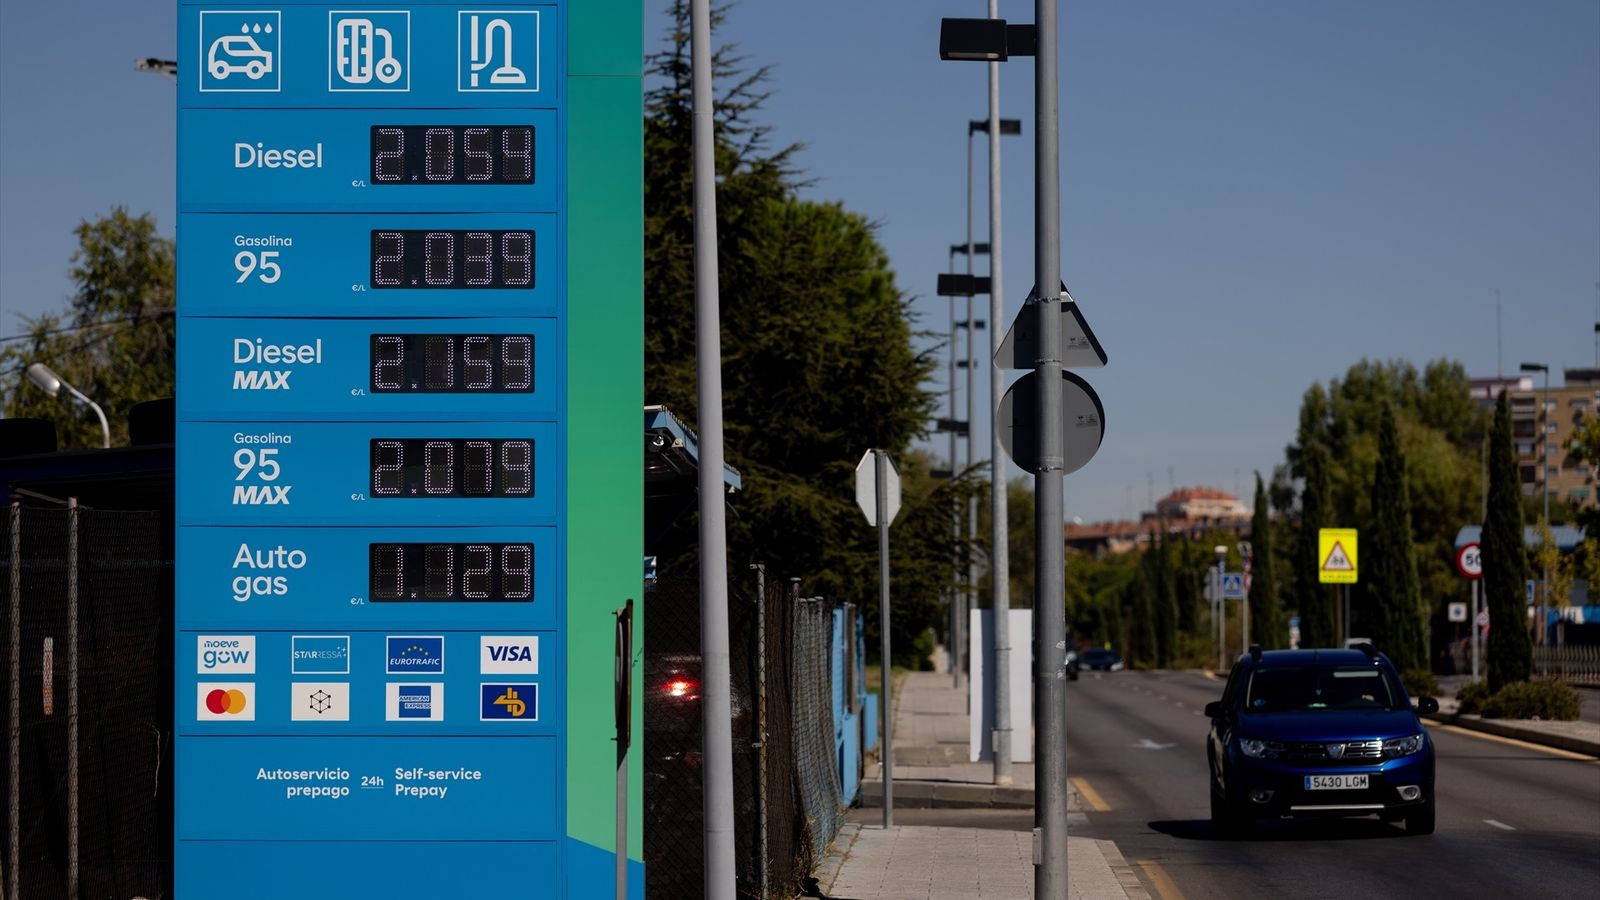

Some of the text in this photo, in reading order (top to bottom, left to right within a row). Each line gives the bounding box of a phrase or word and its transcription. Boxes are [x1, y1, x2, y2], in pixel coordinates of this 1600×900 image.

[234, 142, 322, 169] Diesel
[375, 128, 531, 181] 2.054
[234, 235, 292, 247] Gasolina
[375, 232, 531, 285] 2.039
[234, 251, 281, 284] 95
[352, 284, 366, 292] €/L
[233, 337, 322, 364] Diesel
[375, 336, 531, 389] 2.159
[232, 370, 292, 390] MAX
[351, 388, 366, 396] €/L
[233, 432, 292, 444] Gasolina
[233, 448, 281, 481] 95
[374, 441, 531, 494] 2.079
[232, 485, 292, 505] MAX
[351, 493, 366, 501] €/L
[232, 543, 307, 569] Auto
[396, 545, 531, 599] 1.129
[232, 576, 288, 602] gas
[350, 597, 365, 605] €/L
[204, 640, 240, 648] moeve
[294, 651, 342, 659] STARRESSA
[486, 645, 532, 662] VISA
[389, 658, 440, 666] EUROTRAFIC
[256, 768, 350, 780] Autoservicio
[361, 776, 384, 786] 24h
[395, 768, 482, 780] Self-service
[1313, 775, 1367, 788] 5430 LGM
[287, 785, 350, 799] prepago
[395, 783, 448, 799] Prepay
